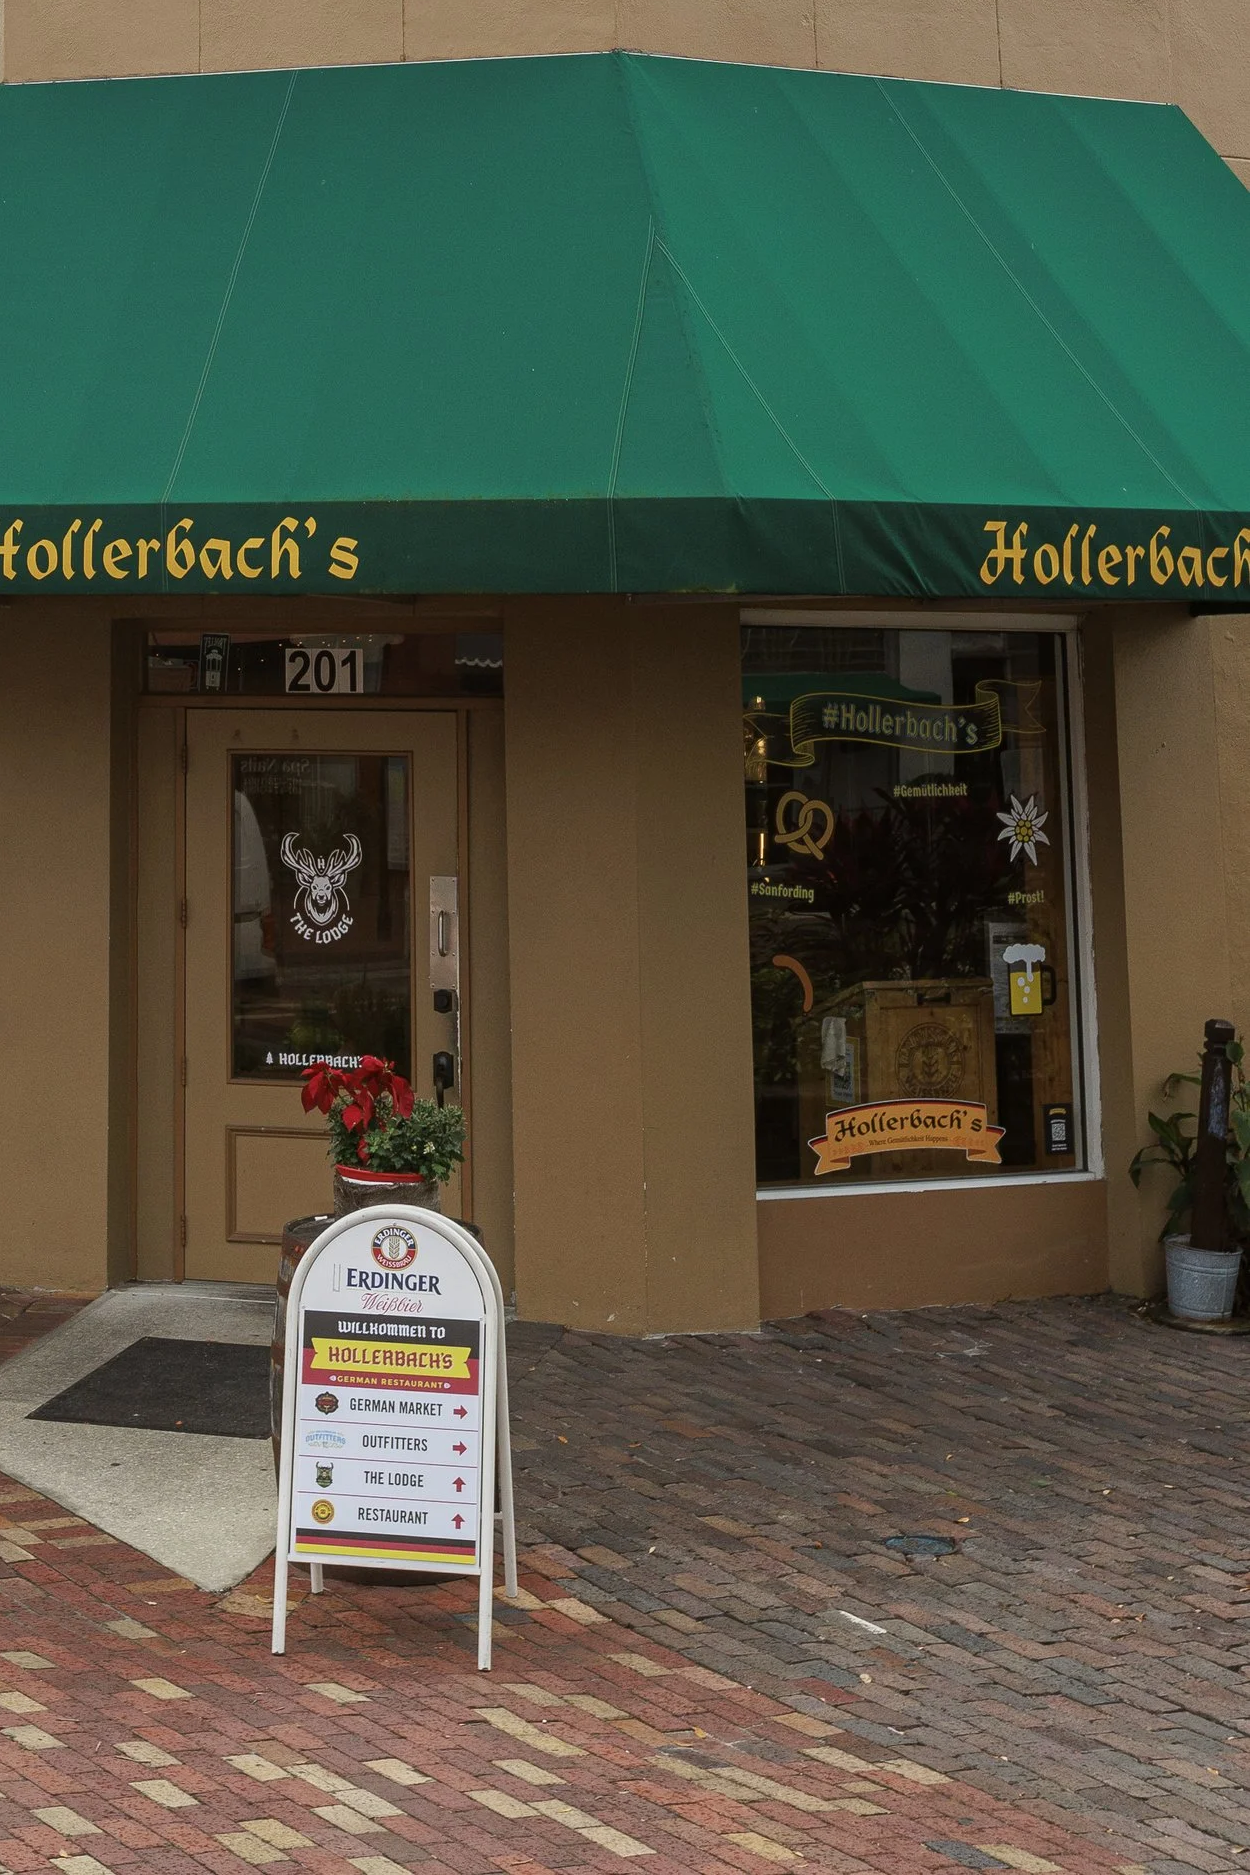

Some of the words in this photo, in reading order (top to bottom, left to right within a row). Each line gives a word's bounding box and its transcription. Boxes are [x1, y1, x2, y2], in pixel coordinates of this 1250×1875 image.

[287, 650, 357, 692] 201
[821, 702, 979, 746] #Hollerbach's
[893, 783, 968, 798] #Gemütlichkeit
[751, 883, 815, 903] #Sanfording
[1007, 890, 1045, 905] #Prost!
[289, 912, 314, 940] THE
[315, 913, 354, 944] LODGE
[834, 1108, 983, 1143] Hollerbach's
[374, 1228, 414, 1246] ERDINGER
[346, 1268, 442, 1295] ERDINGER
[361, 1292, 424, 1315] Weißbier
[337, 1320, 427, 1338] WILLKOMMEN
[430, 1326, 446, 1339] TO
[328, 1346, 453, 1370] HOLLERBACH'S
[337, 1375, 378, 1385] GERMAN
[381, 1378, 443, 1389] RESTAURANT
[350, 1397, 396, 1414] GERMAN
[399, 1401, 443, 1417] MARKET
[305, 1433, 346, 1445] OUTFITTERS
[362, 1434, 428, 1452] OUTFITTERS
[364, 1470, 385, 1485] THE
[388, 1472, 424, 1488] LODGE
[358, 1507, 429, 1525] RESTAURANT
